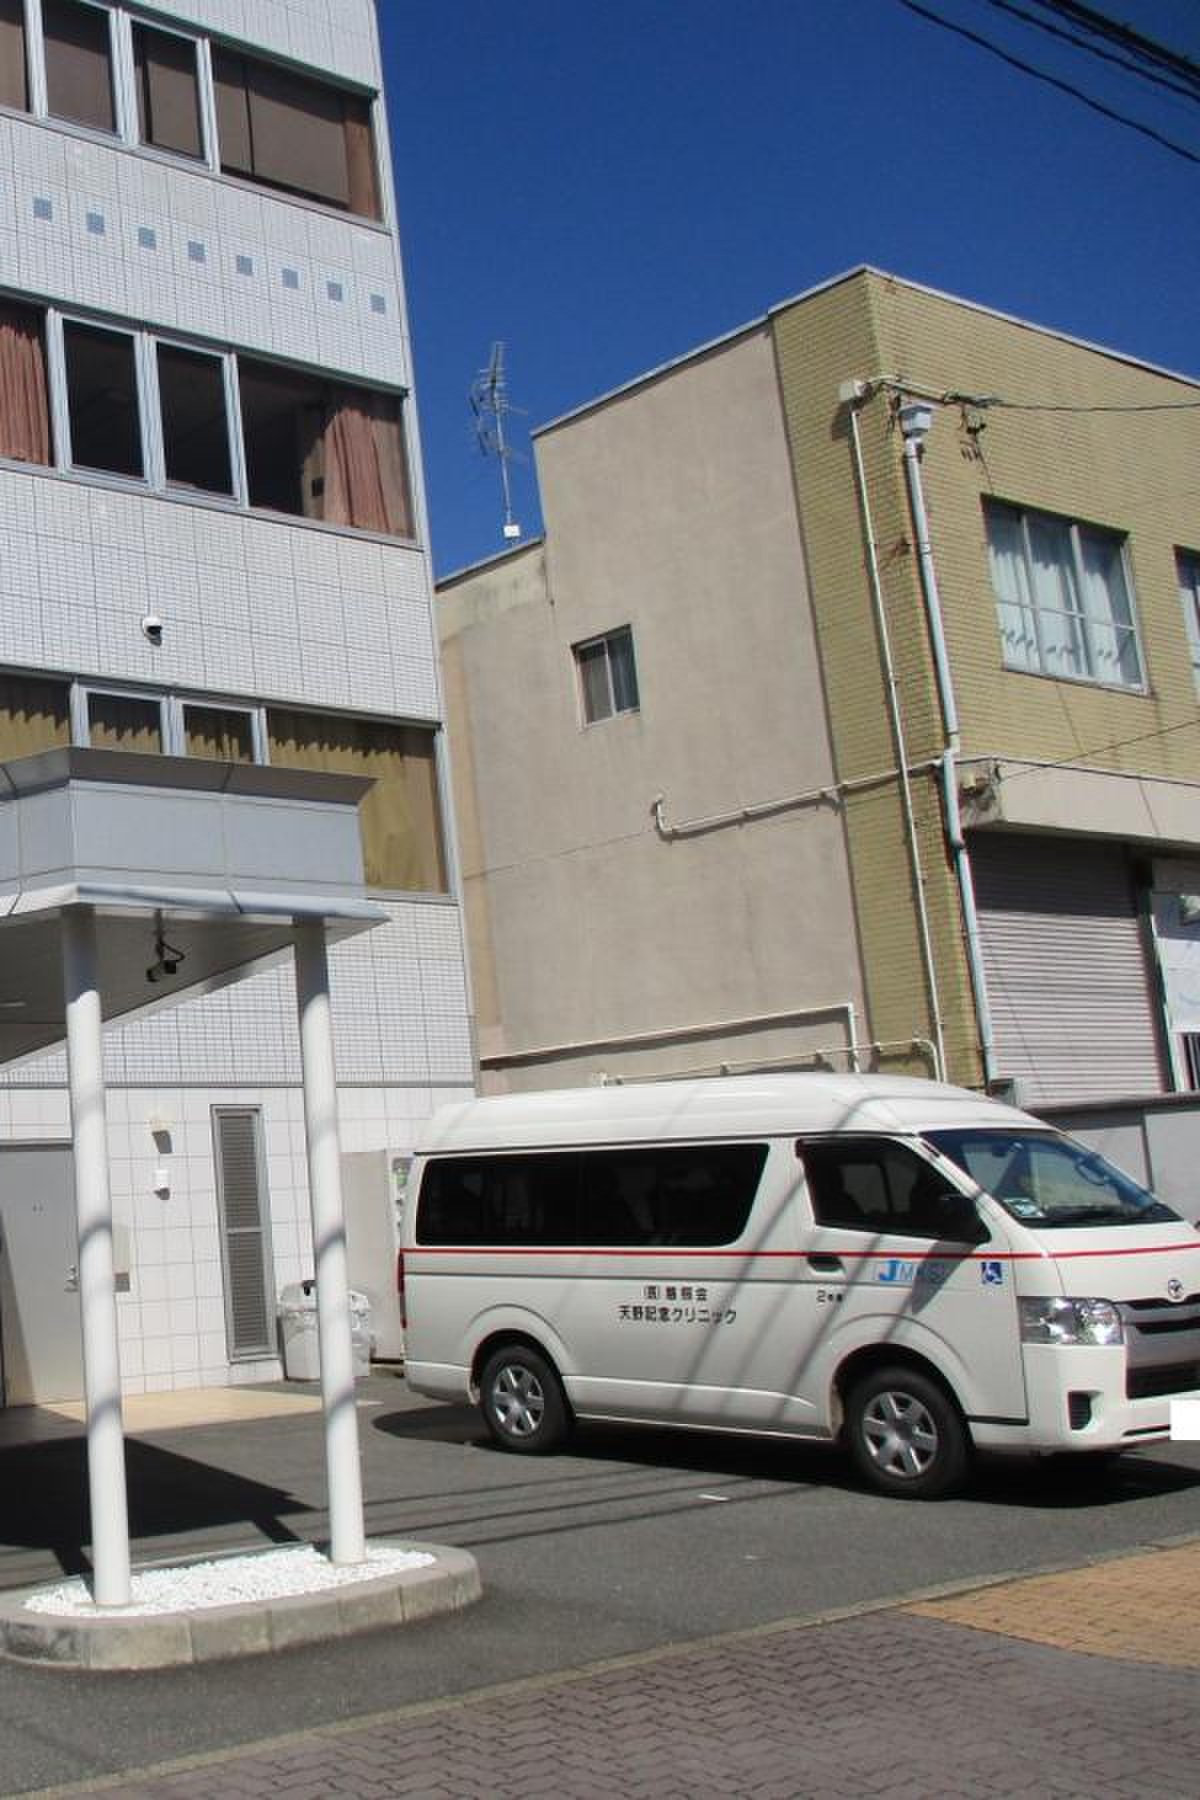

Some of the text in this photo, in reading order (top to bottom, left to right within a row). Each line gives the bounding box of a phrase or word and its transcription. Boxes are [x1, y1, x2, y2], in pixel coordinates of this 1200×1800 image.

[618, 1304, 737, 1325] 天野記念クリニック
